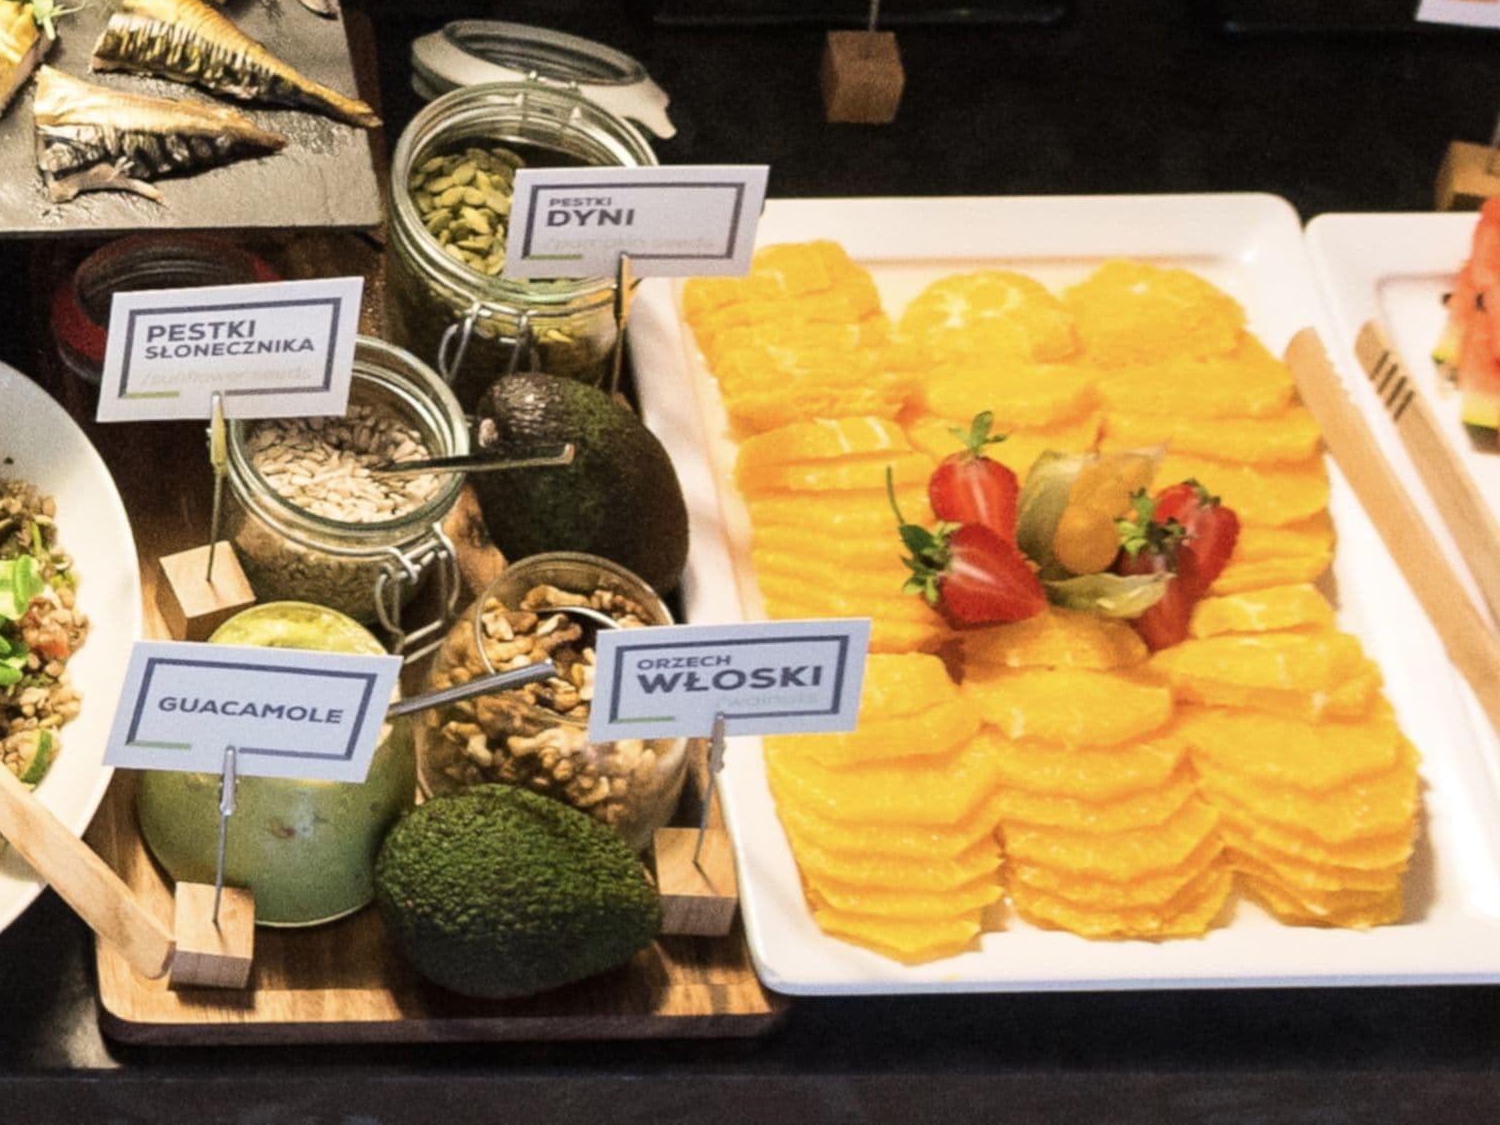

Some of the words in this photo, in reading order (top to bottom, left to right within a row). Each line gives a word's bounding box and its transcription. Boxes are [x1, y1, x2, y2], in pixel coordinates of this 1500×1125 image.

[548, 196, 612, 208] PESTKI
[547, 208, 635, 228] DYNI
[146, 320, 257, 343] PESTKI
[145, 338, 315, 360] SŁONECZNIKA
[637, 654, 732, 671] ORZECH
[637, 665, 823, 695] WŁOSKI
[158, 695, 344, 725] GUACAMOLE
